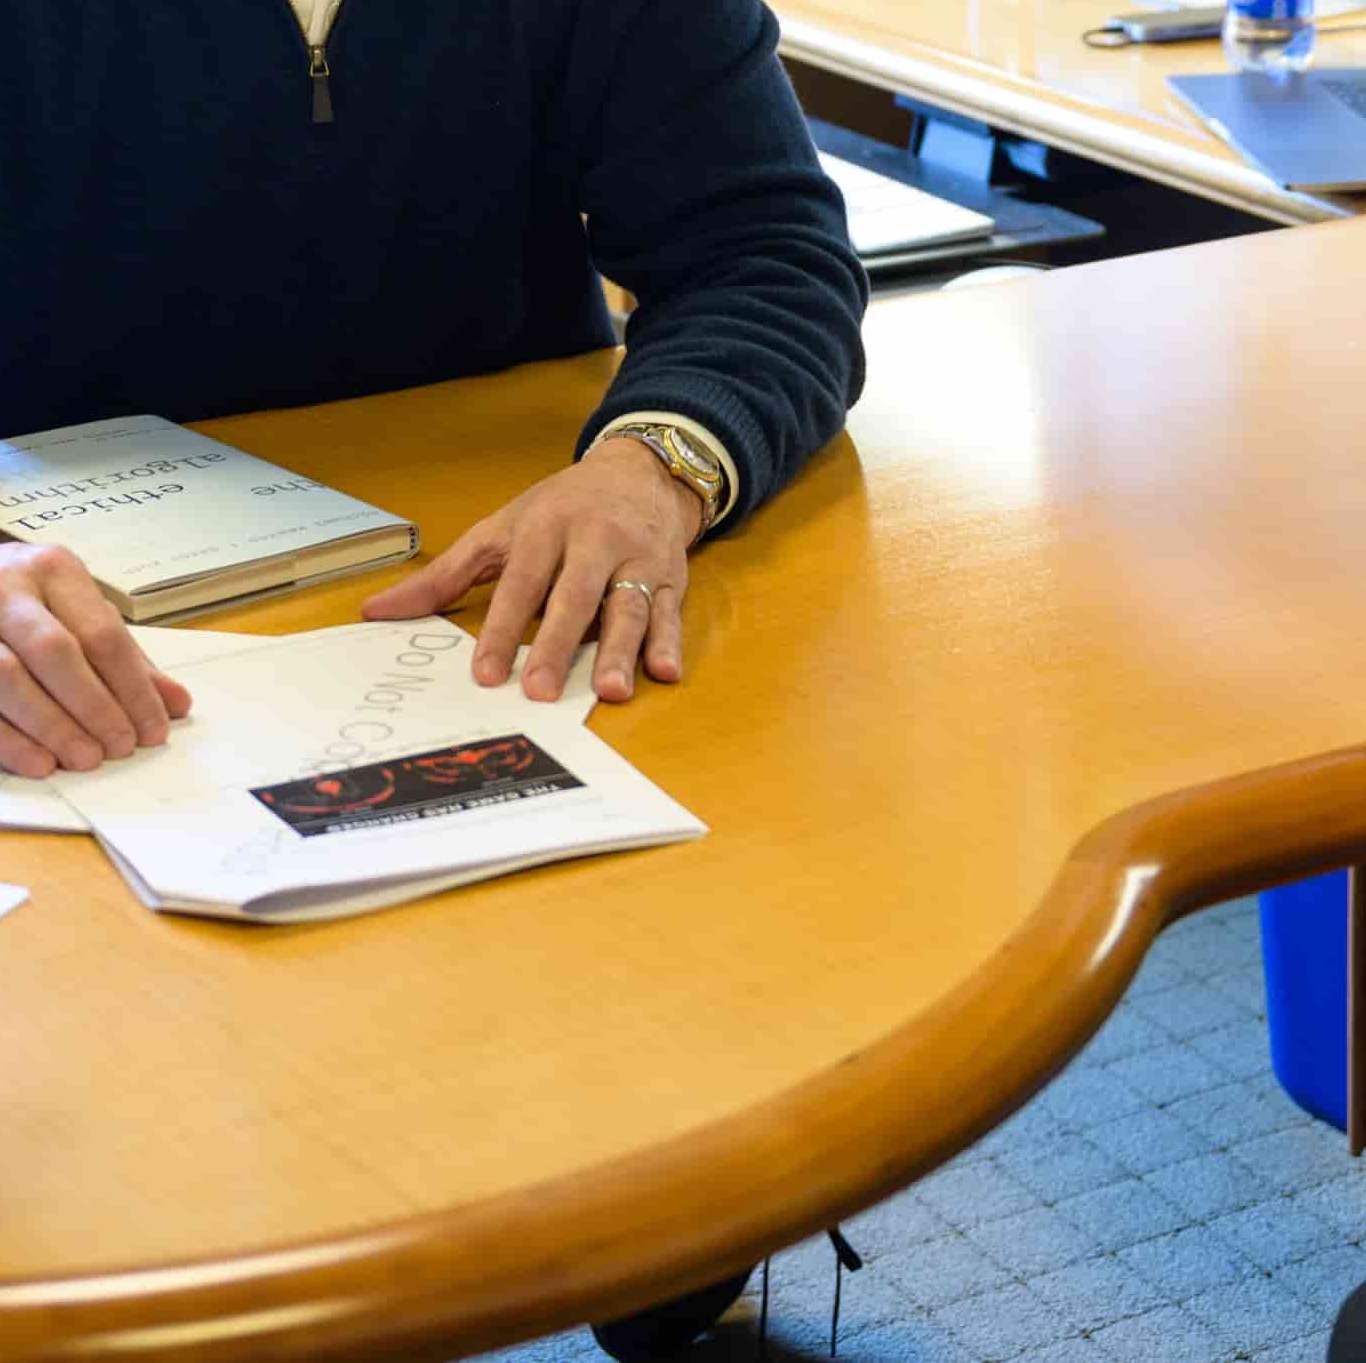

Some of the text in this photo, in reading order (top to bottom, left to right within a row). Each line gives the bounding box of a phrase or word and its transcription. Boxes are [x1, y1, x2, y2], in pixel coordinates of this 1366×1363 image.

[9, 482, 185, 531] ethical
[395, 633, 463, 667] Do
[354, 671, 436, 713] Not
